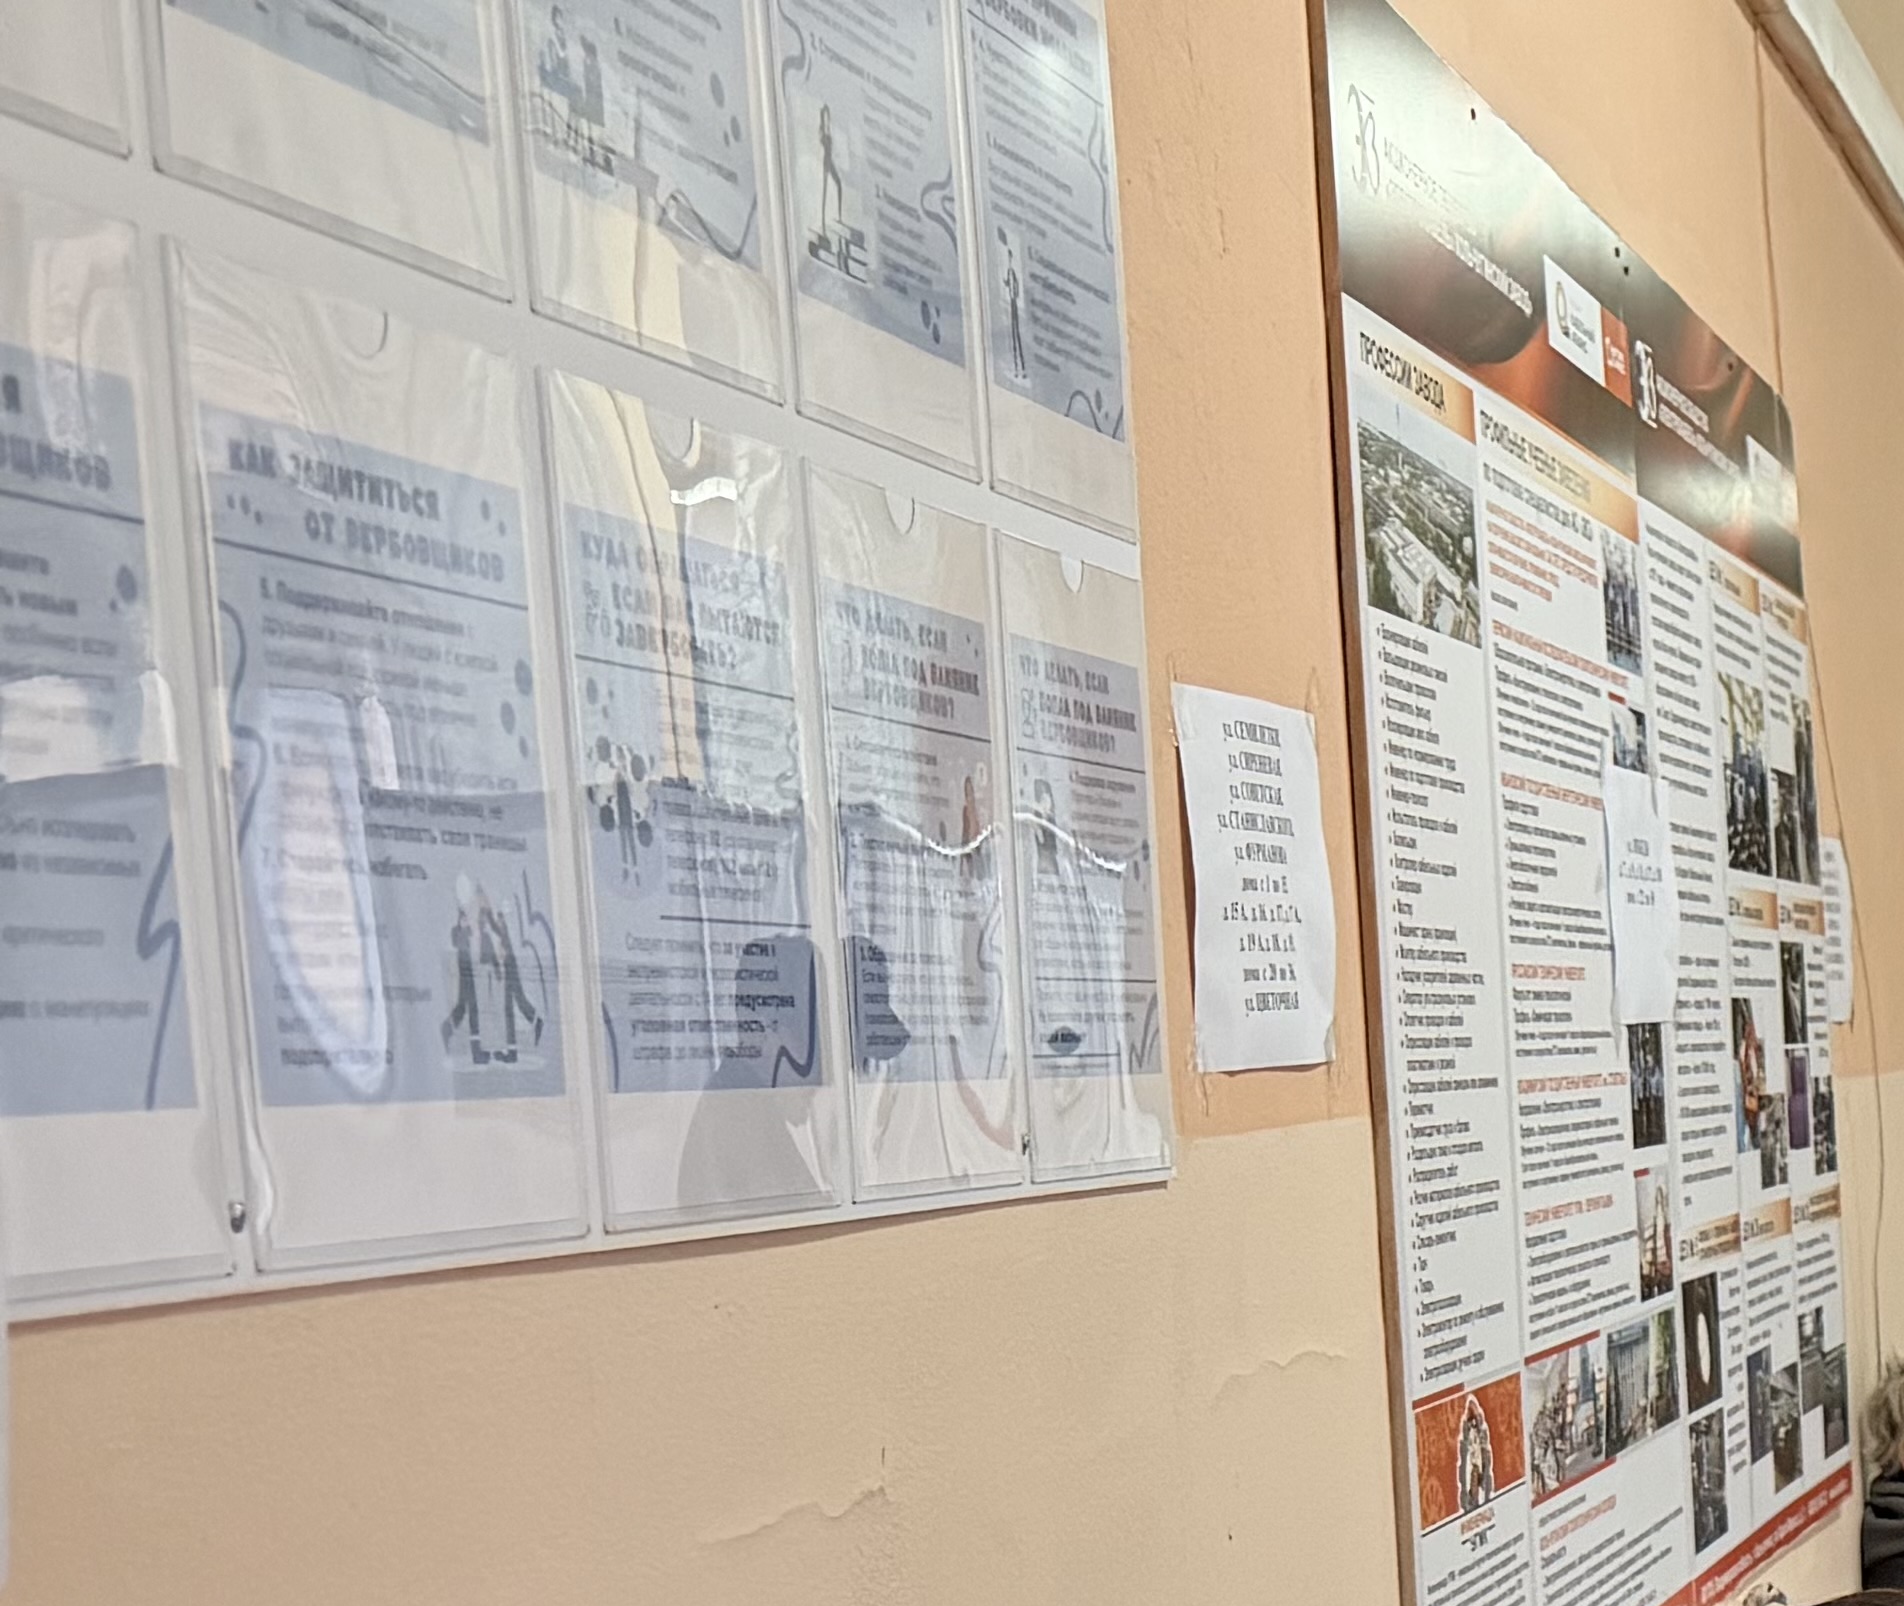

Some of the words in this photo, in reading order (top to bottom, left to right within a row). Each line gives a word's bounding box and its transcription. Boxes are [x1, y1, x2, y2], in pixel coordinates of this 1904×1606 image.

[227, 439, 277, 479] КАК
[289, 453, 440, 520] ЗАЩИТИТЬСЯ
[304, 508, 335, 544] ОТ
[345, 516, 503, 582] ВЕРБОВЩИКОВ
[919, 623, 947, 652] ЕСЛИ
[903, 655, 928, 687] ПОД
[1018, 654, 1039, 679] ЧТО
[1085, 669, 1109, 695] ЕСЛИ
[1074, 700, 1094, 726] ПОД
